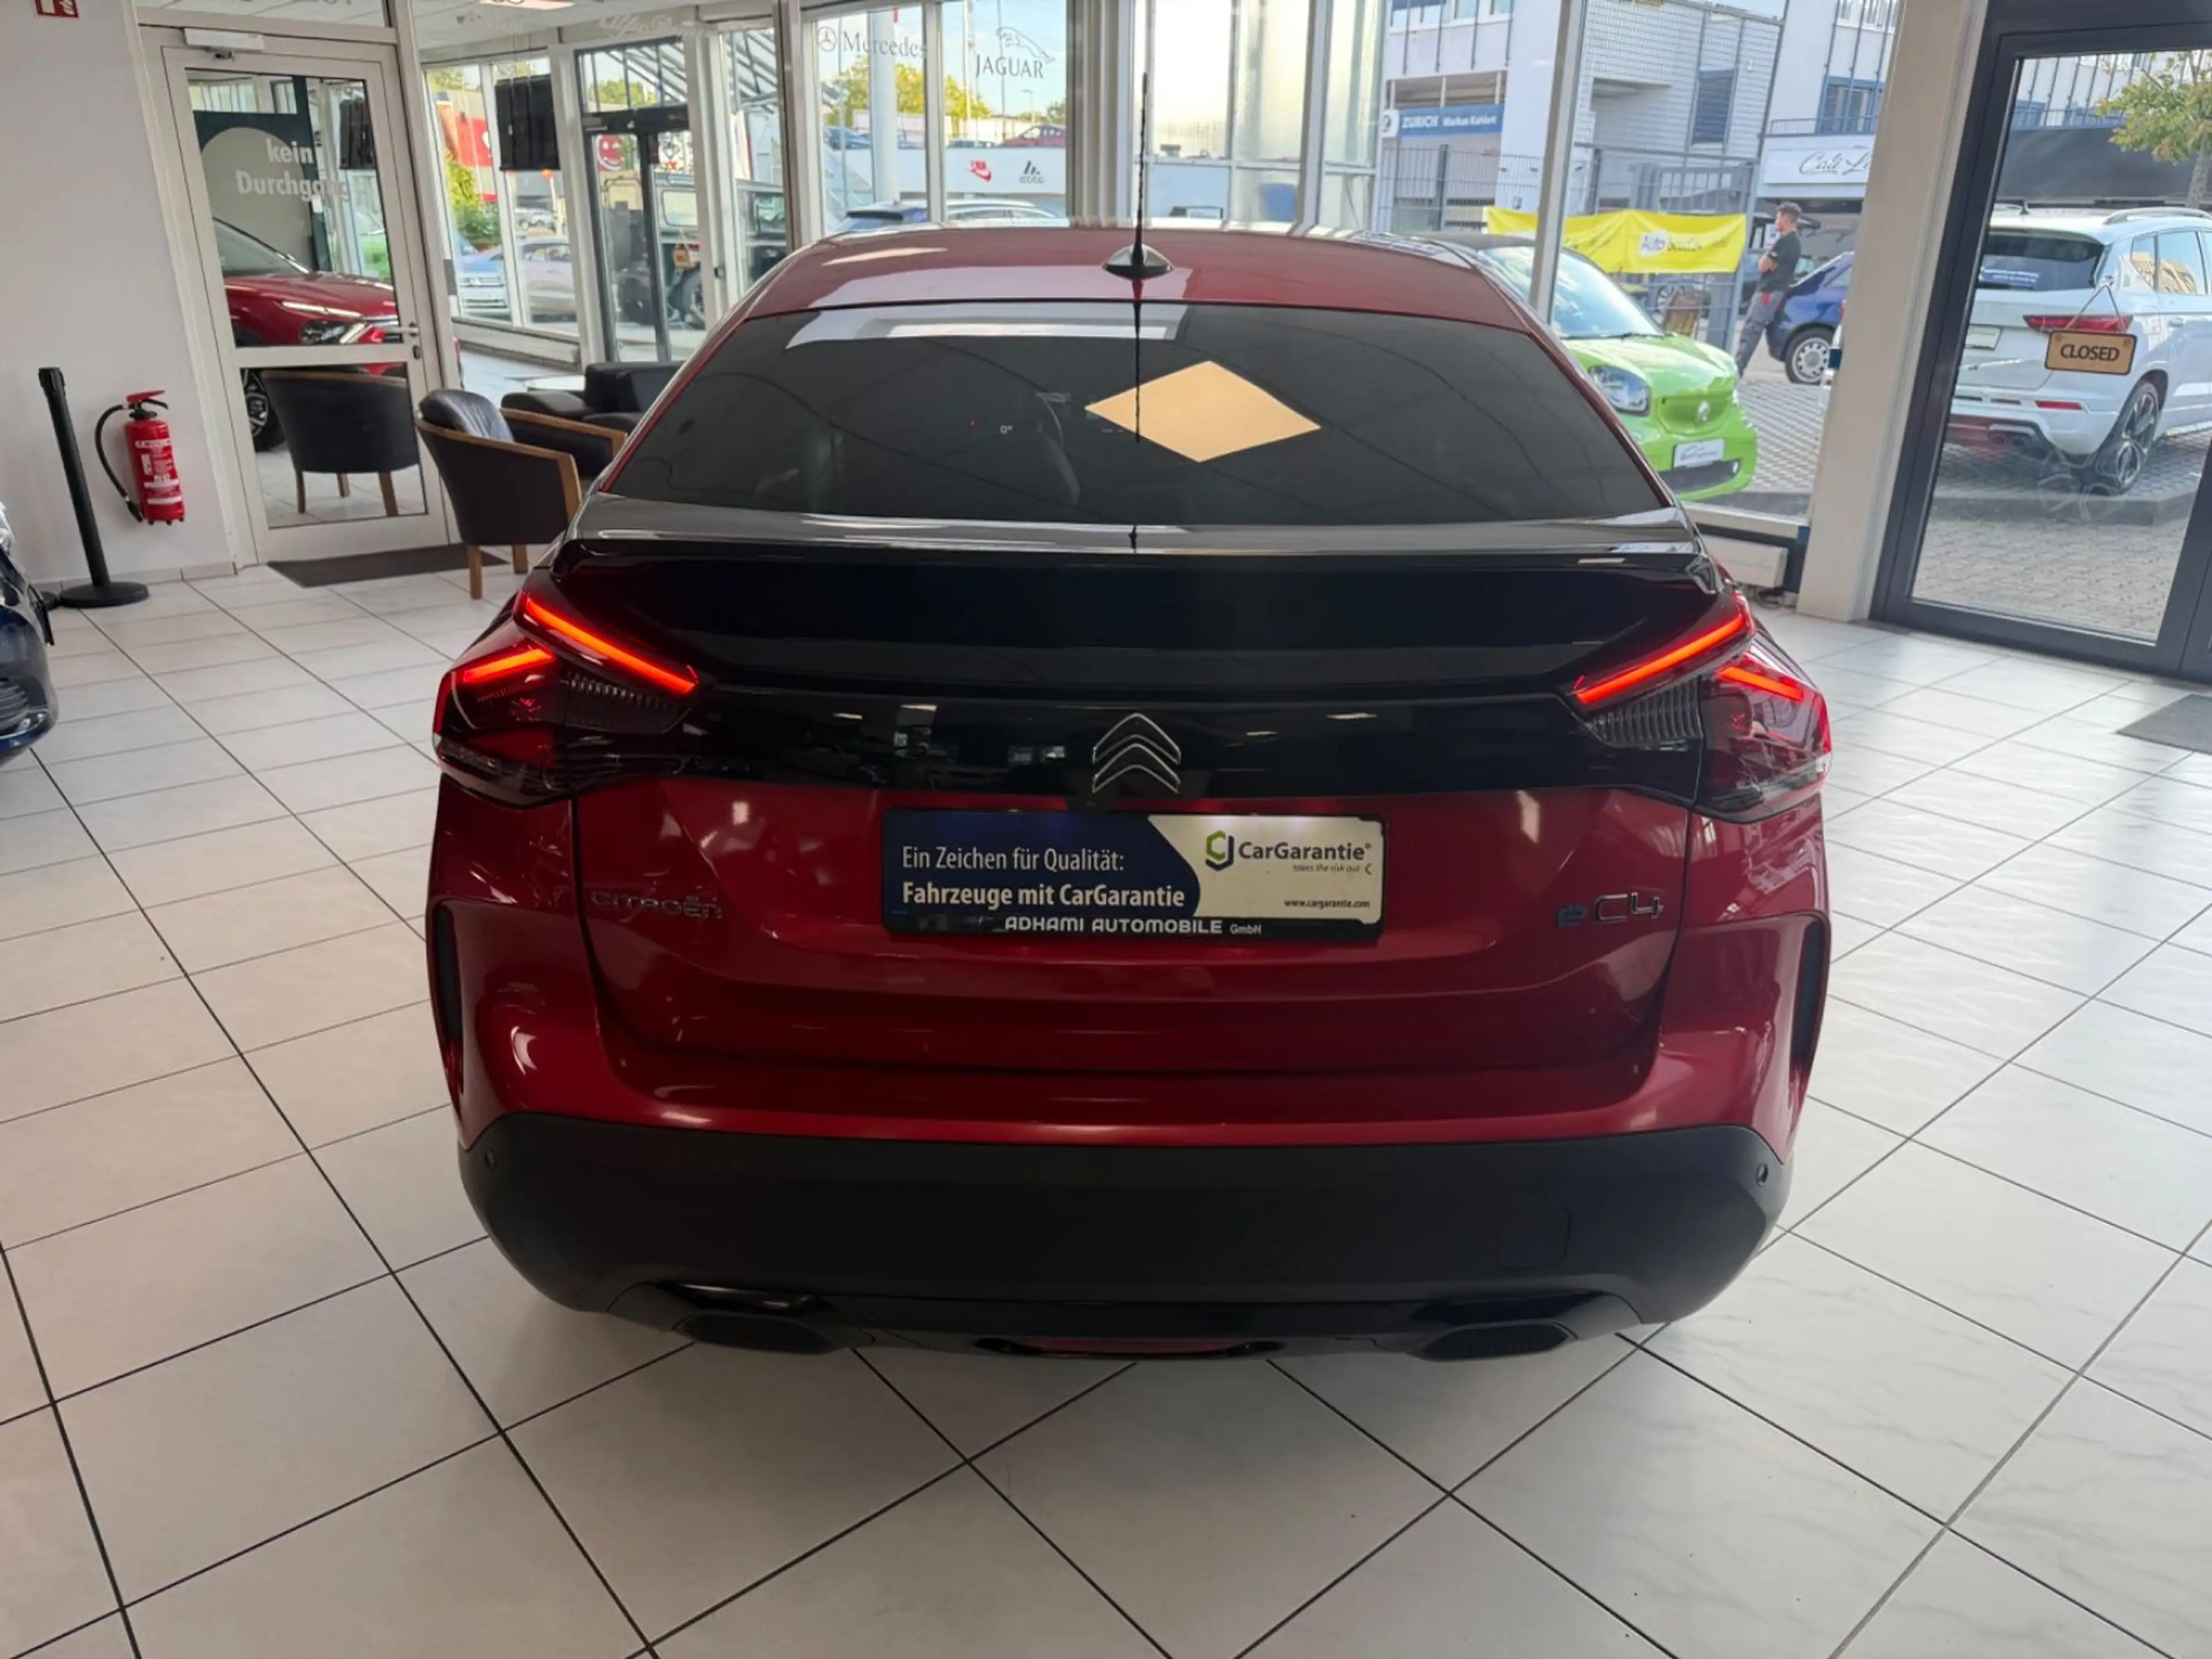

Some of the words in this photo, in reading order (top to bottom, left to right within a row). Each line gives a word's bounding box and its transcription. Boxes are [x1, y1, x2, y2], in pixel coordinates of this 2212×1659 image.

[842, 30, 927, 59] Mercedes
[975, 55, 1044, 79] JAGUAR
[265, 138, 313, 164] kein
[2060, 344, 2120, 362] CLOSED
[903, 846, 930, 868] Ein
[936, 846, 1007, 870] Zeichen
[1013, 847, 1039, 870] für
[1044, 847, 1124, 873] Qualität:
[1238, 841, 1365, 860] CarGarantie
[903, 881, 1013, 911] Fahrzeuge
[1018, 883, 1055, 906] mit
[1059, 884, 1185, 907] CarGarantie
[1284, 899, 1370, 910] www.cargarantie.com
[1005, 916, 1084, 933] ADHAMI
[1092, 919, 1222, 934] AUTOMOBILE
[1229, 923, 1262, 935] GmbH
